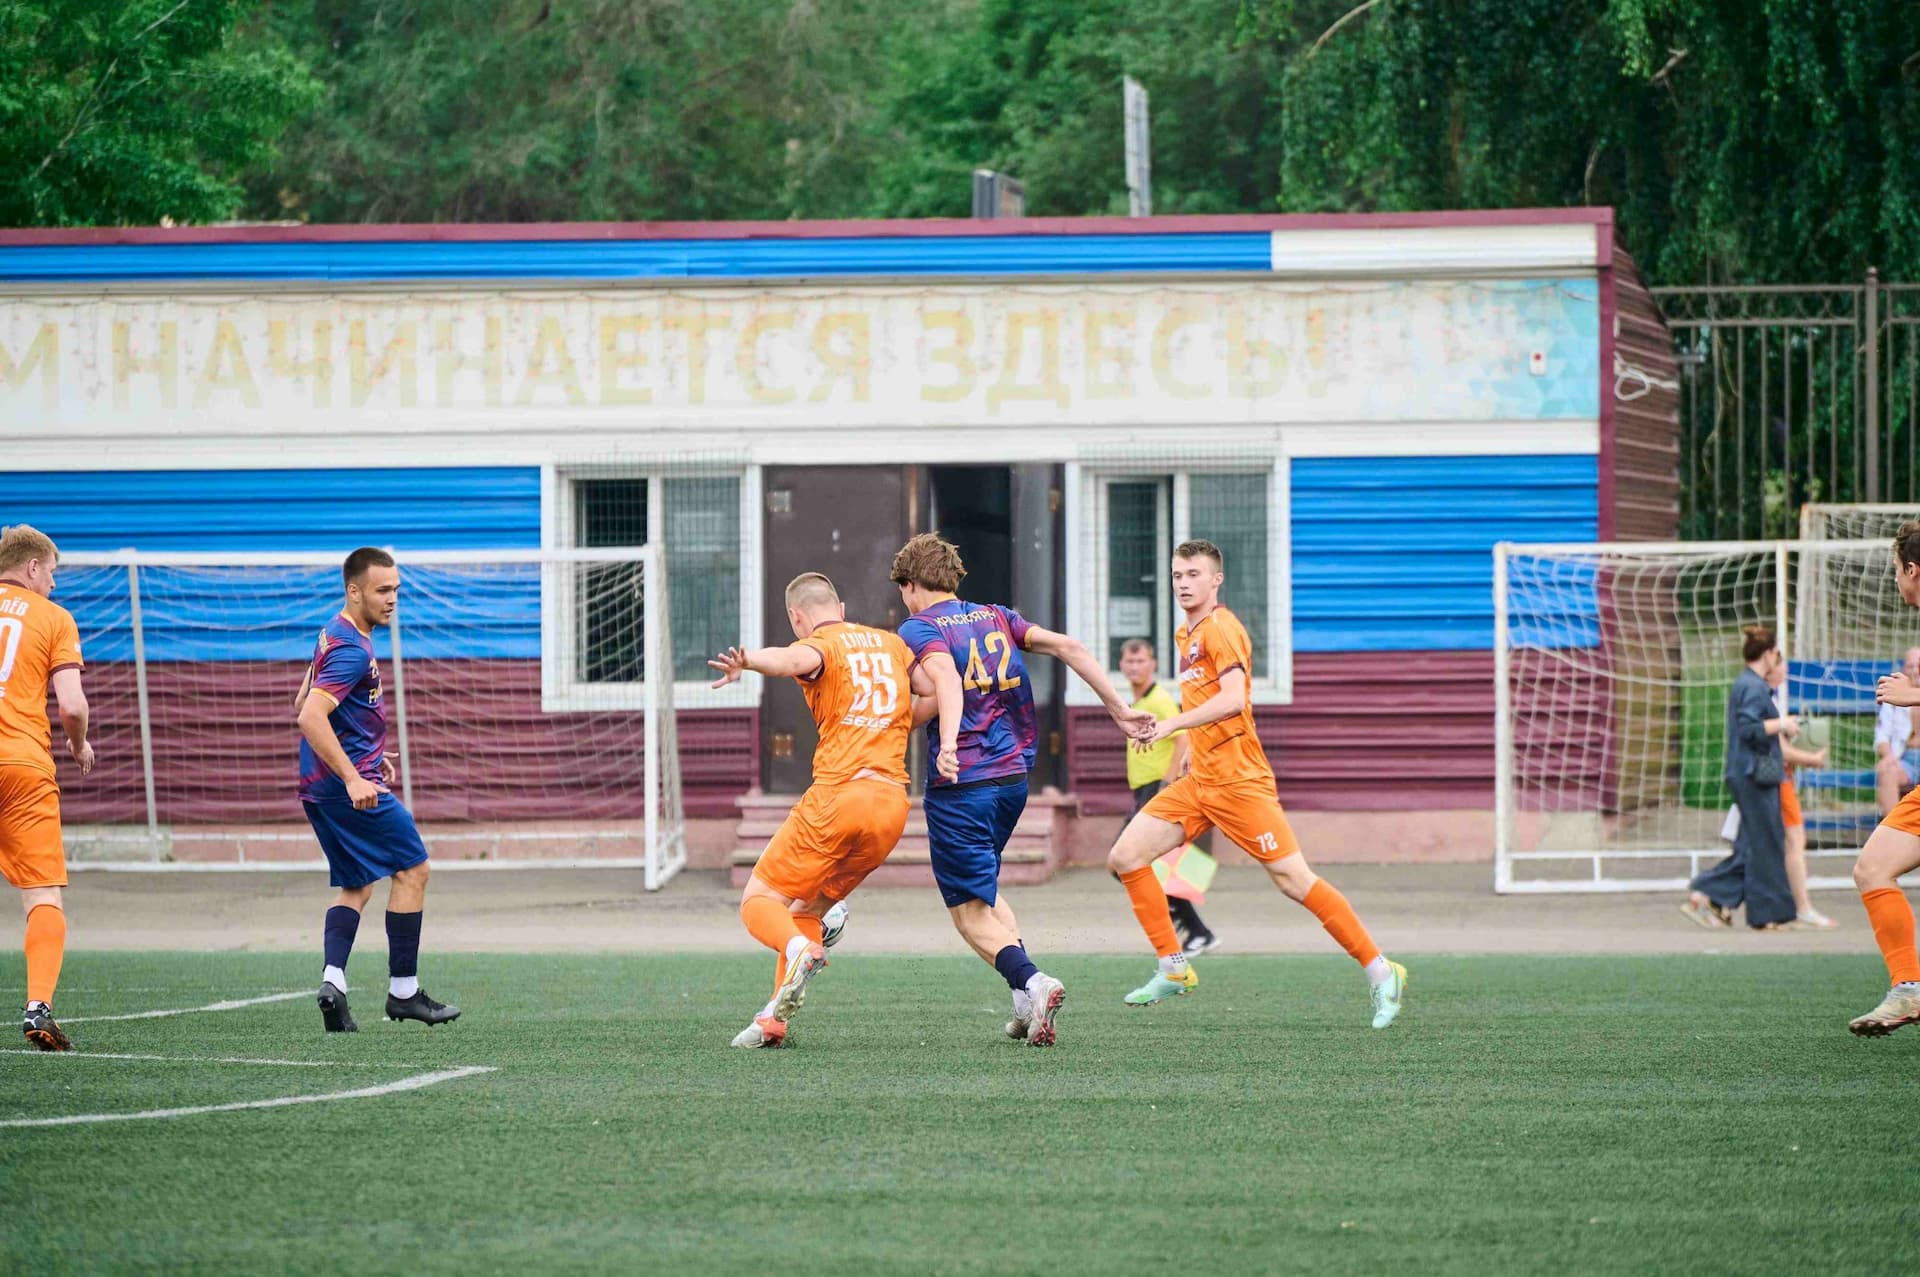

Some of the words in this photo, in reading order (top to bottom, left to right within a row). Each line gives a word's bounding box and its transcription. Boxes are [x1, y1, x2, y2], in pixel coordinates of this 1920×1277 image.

[112, 311, 871, 409] НАЧИНАЕТСЯ
[920, 307, 1328, 414] ЗДЕСЬ!
[846, 651, 897, 714] 55
[963, 630, 1021, 696] 42
[1255, 832, 1279, 853] 72
